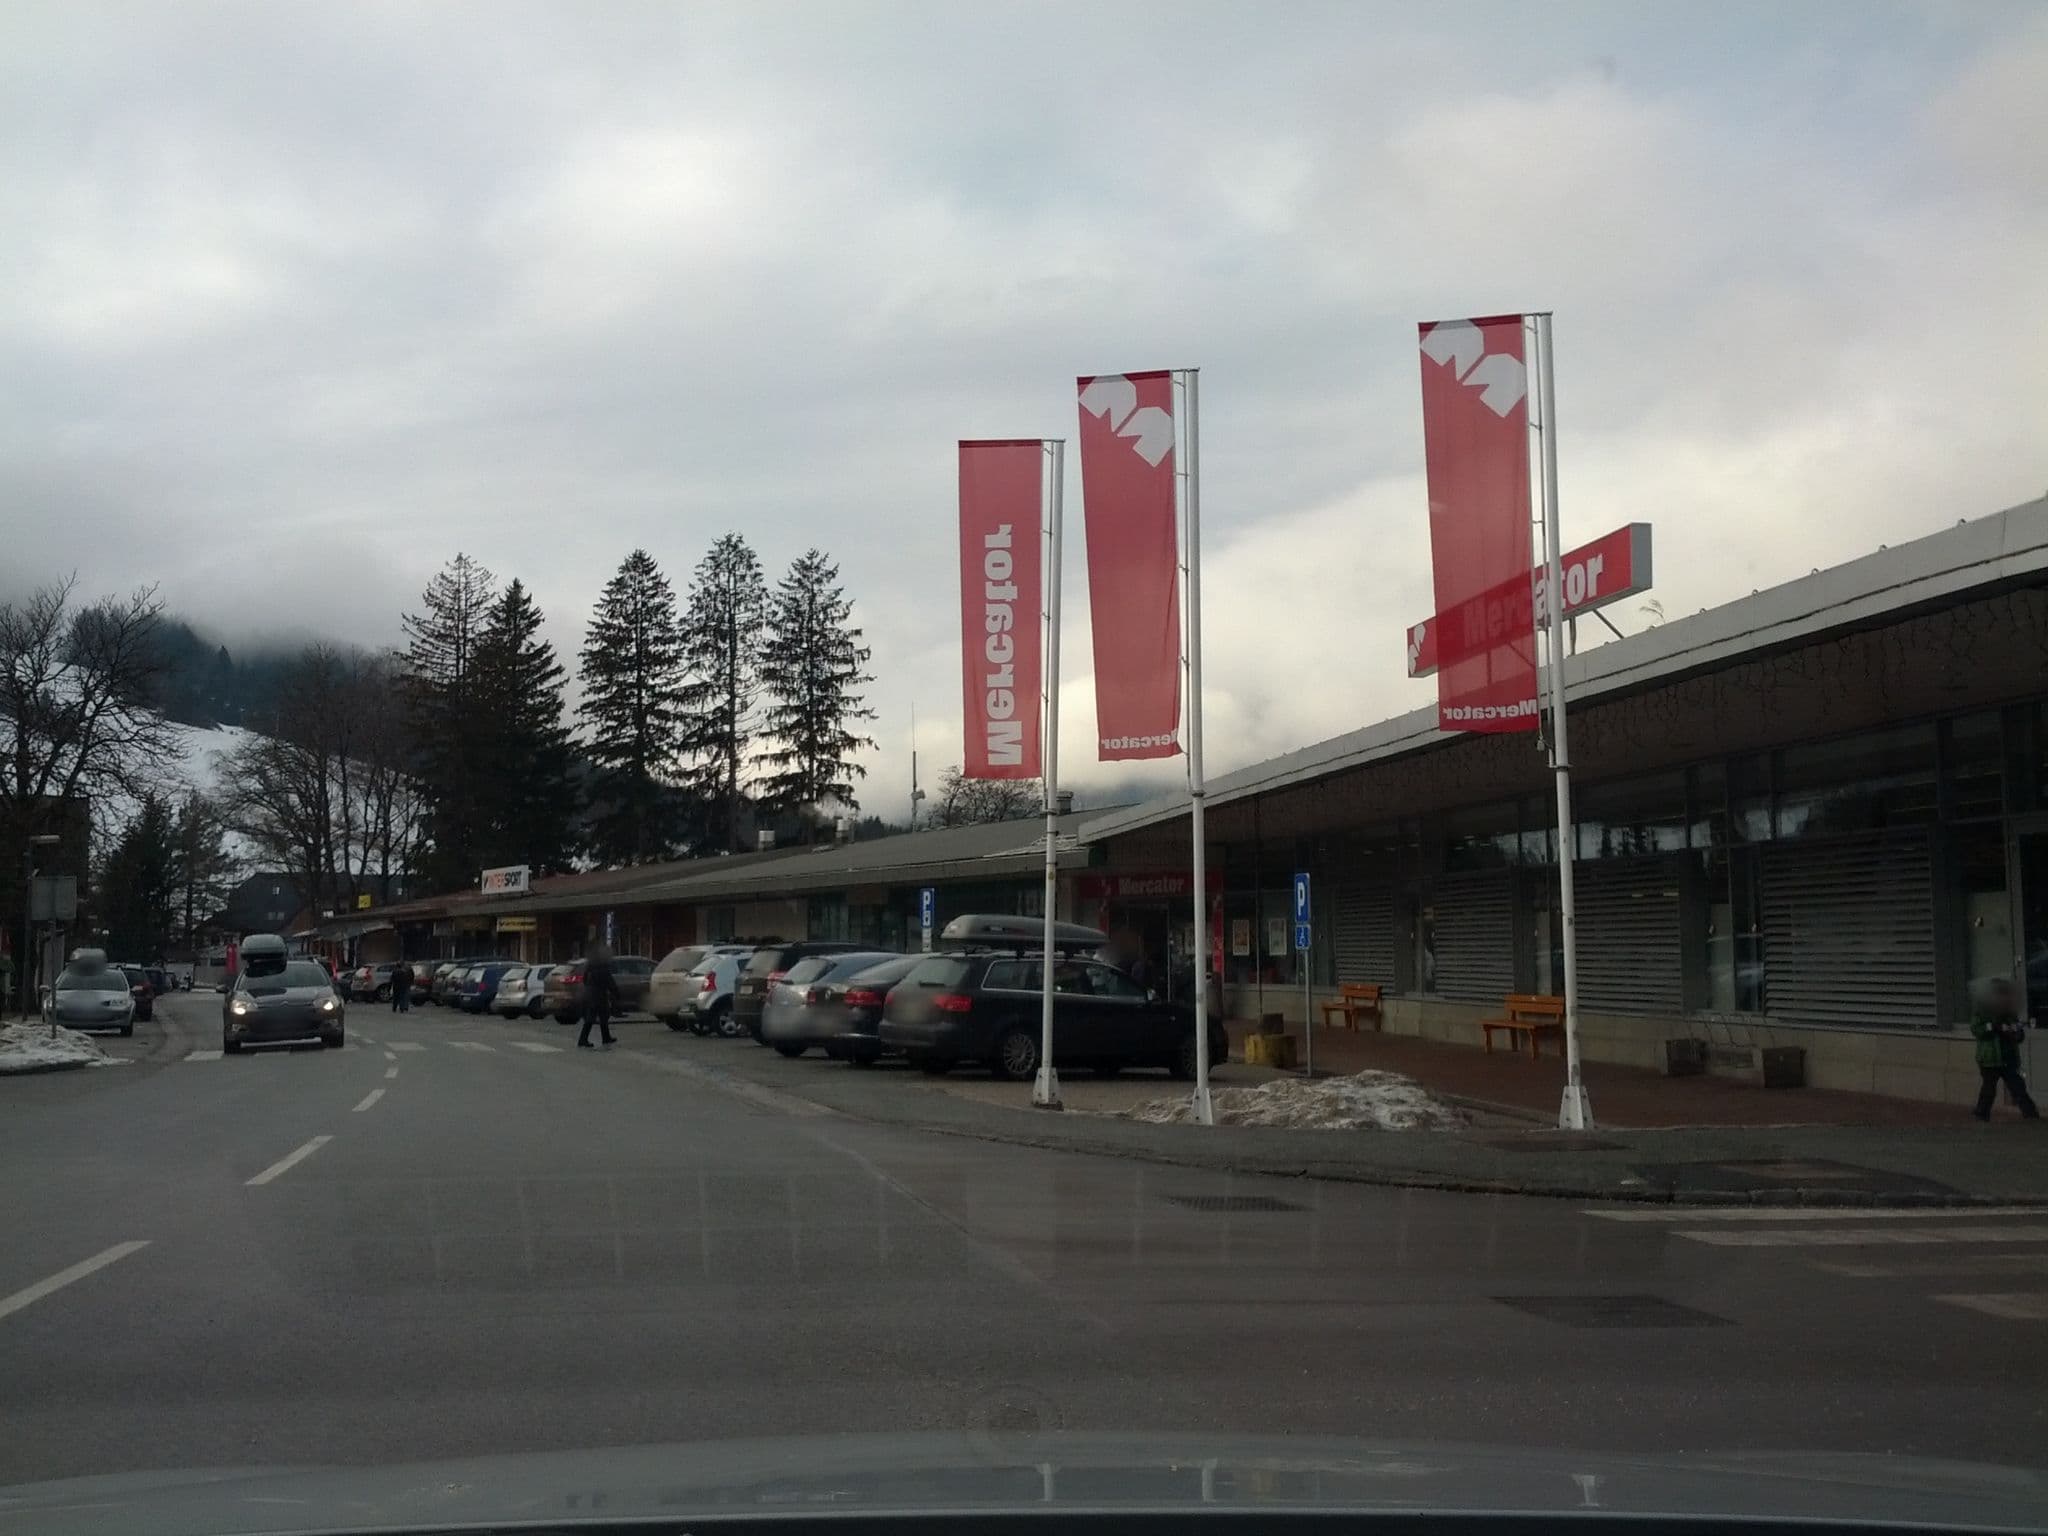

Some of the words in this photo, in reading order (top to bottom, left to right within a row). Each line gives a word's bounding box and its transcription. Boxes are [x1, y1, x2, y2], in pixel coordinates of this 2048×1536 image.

[1119, 876, 1185, 896] Mercator
[922, 890, 931, 911] P
[1297, 881, 1306, 917] P
